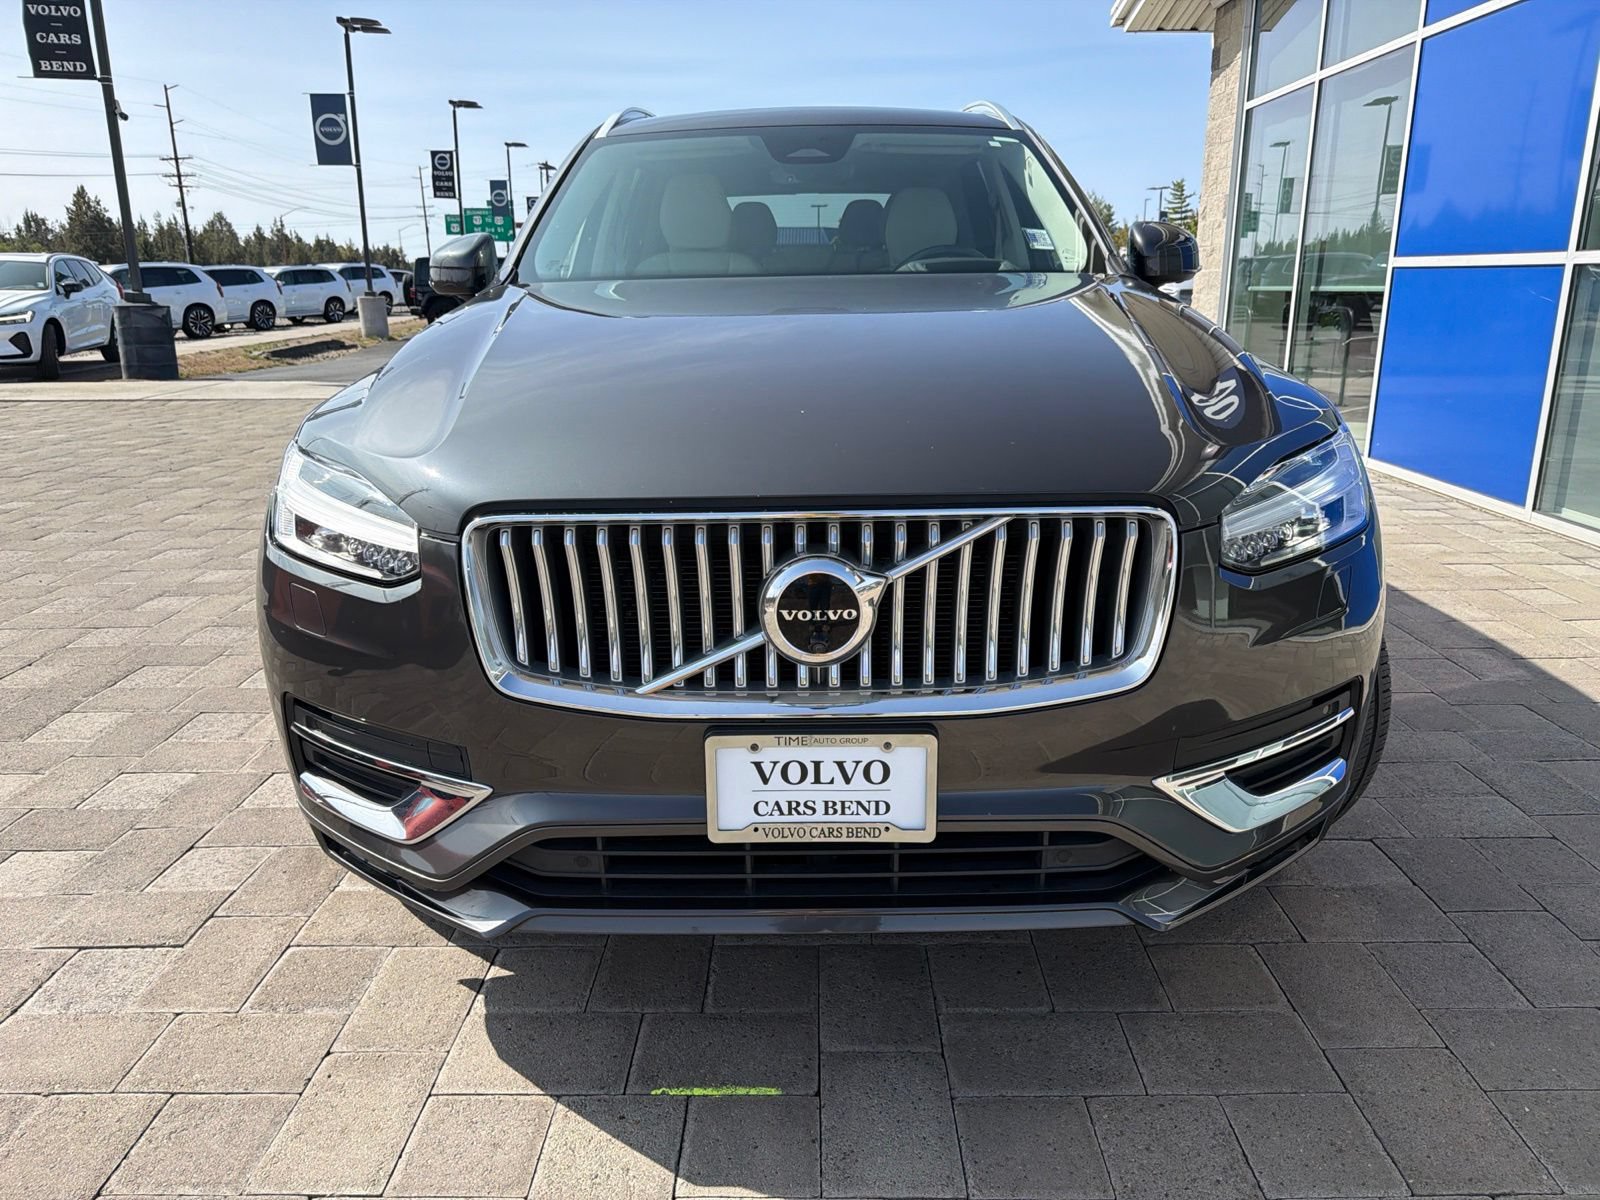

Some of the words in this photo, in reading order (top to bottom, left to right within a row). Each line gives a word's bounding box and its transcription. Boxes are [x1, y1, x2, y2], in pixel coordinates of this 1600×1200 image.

[27, 4, 81, 17] VOLVO
[36, 32, 82, 45] CARS
[39, 60, 87, 72] BEND
[779, 609, 858, 621] VOLVO
[774, 736, 809, 746] TIME
[813, 737, 837, 745] AUTO
[839, 737, 869, 745] GROUP
[751, 760, 891, 785] VOLVO
[753, 800, 817, 816] CARS
[822, 800, 891, 816] BEND
[762, 826, 806, 839] VOLVO
[809, 826, 843, 839] CARS
[845, 826, 881, 839] BEND
